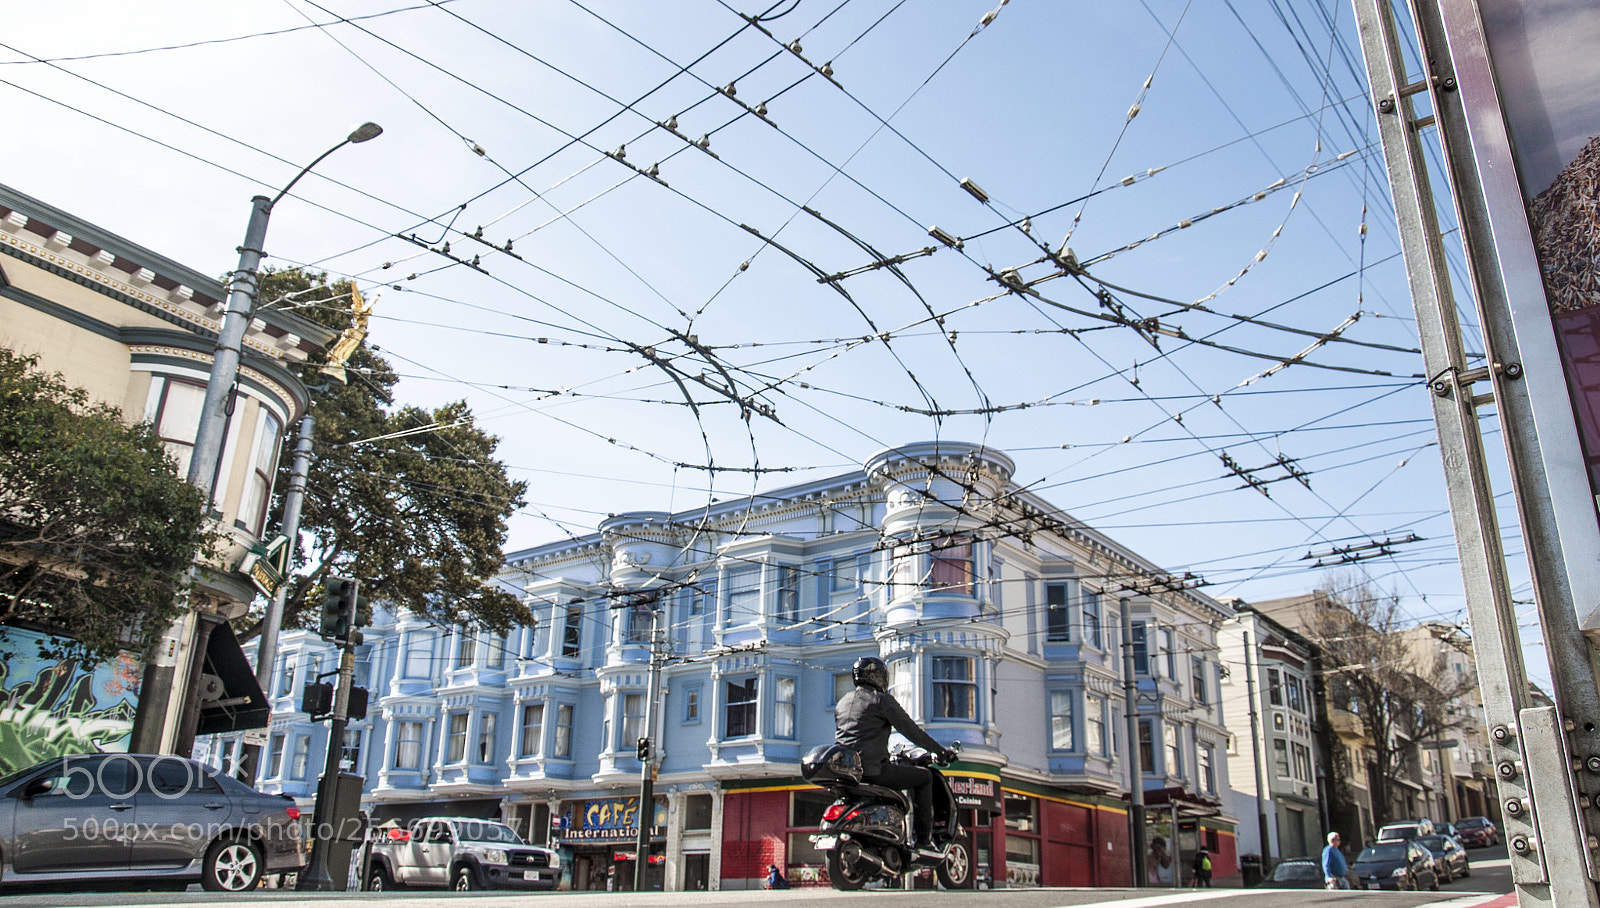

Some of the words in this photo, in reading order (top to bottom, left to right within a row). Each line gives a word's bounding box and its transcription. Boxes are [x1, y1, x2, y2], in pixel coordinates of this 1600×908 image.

[948, 777, 994, 797] derland
[587, 798, 637, 827] CAFÉ
[565, 825, 658, 839] Internatiol
